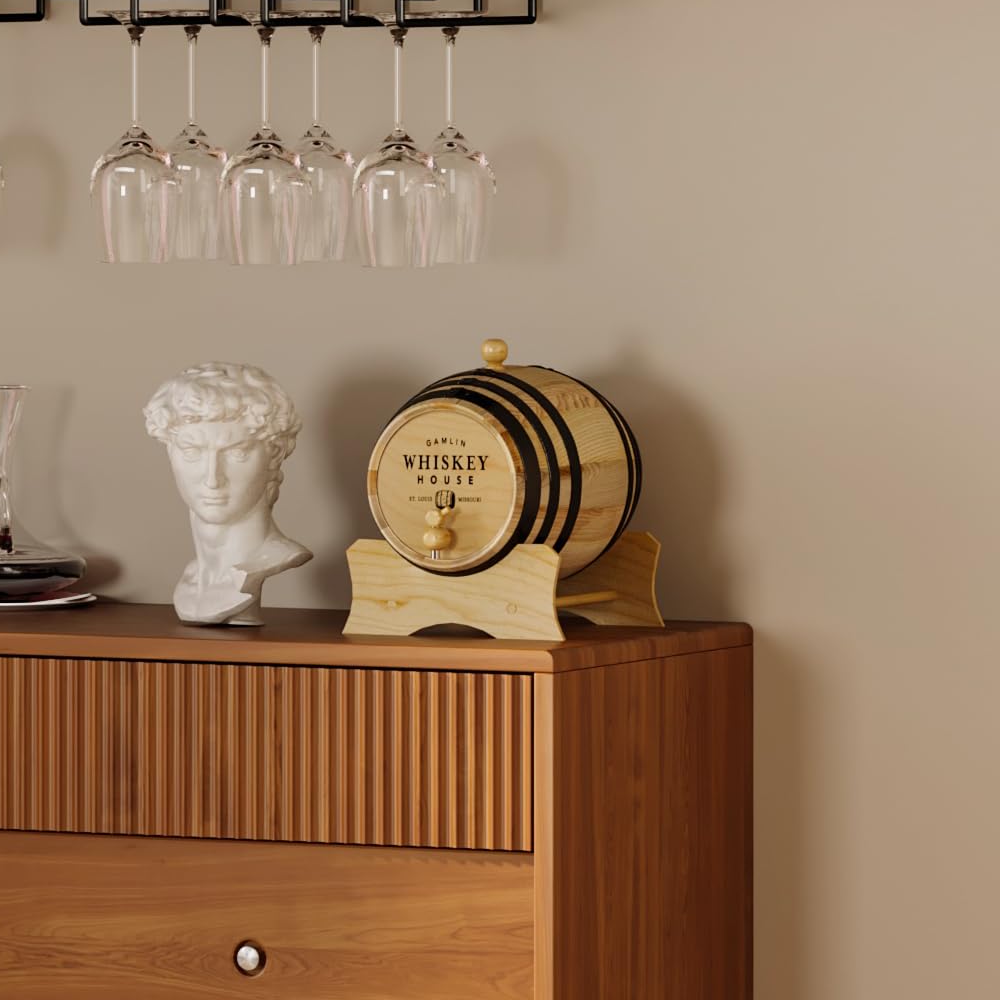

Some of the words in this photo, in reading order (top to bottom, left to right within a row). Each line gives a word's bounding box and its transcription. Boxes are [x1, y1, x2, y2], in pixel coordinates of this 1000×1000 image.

[426, 437, 466, 447] GAMLIN
[403, 454, 489, 471] WHISKEY
[417, 475, 474, 485] HOUSE
